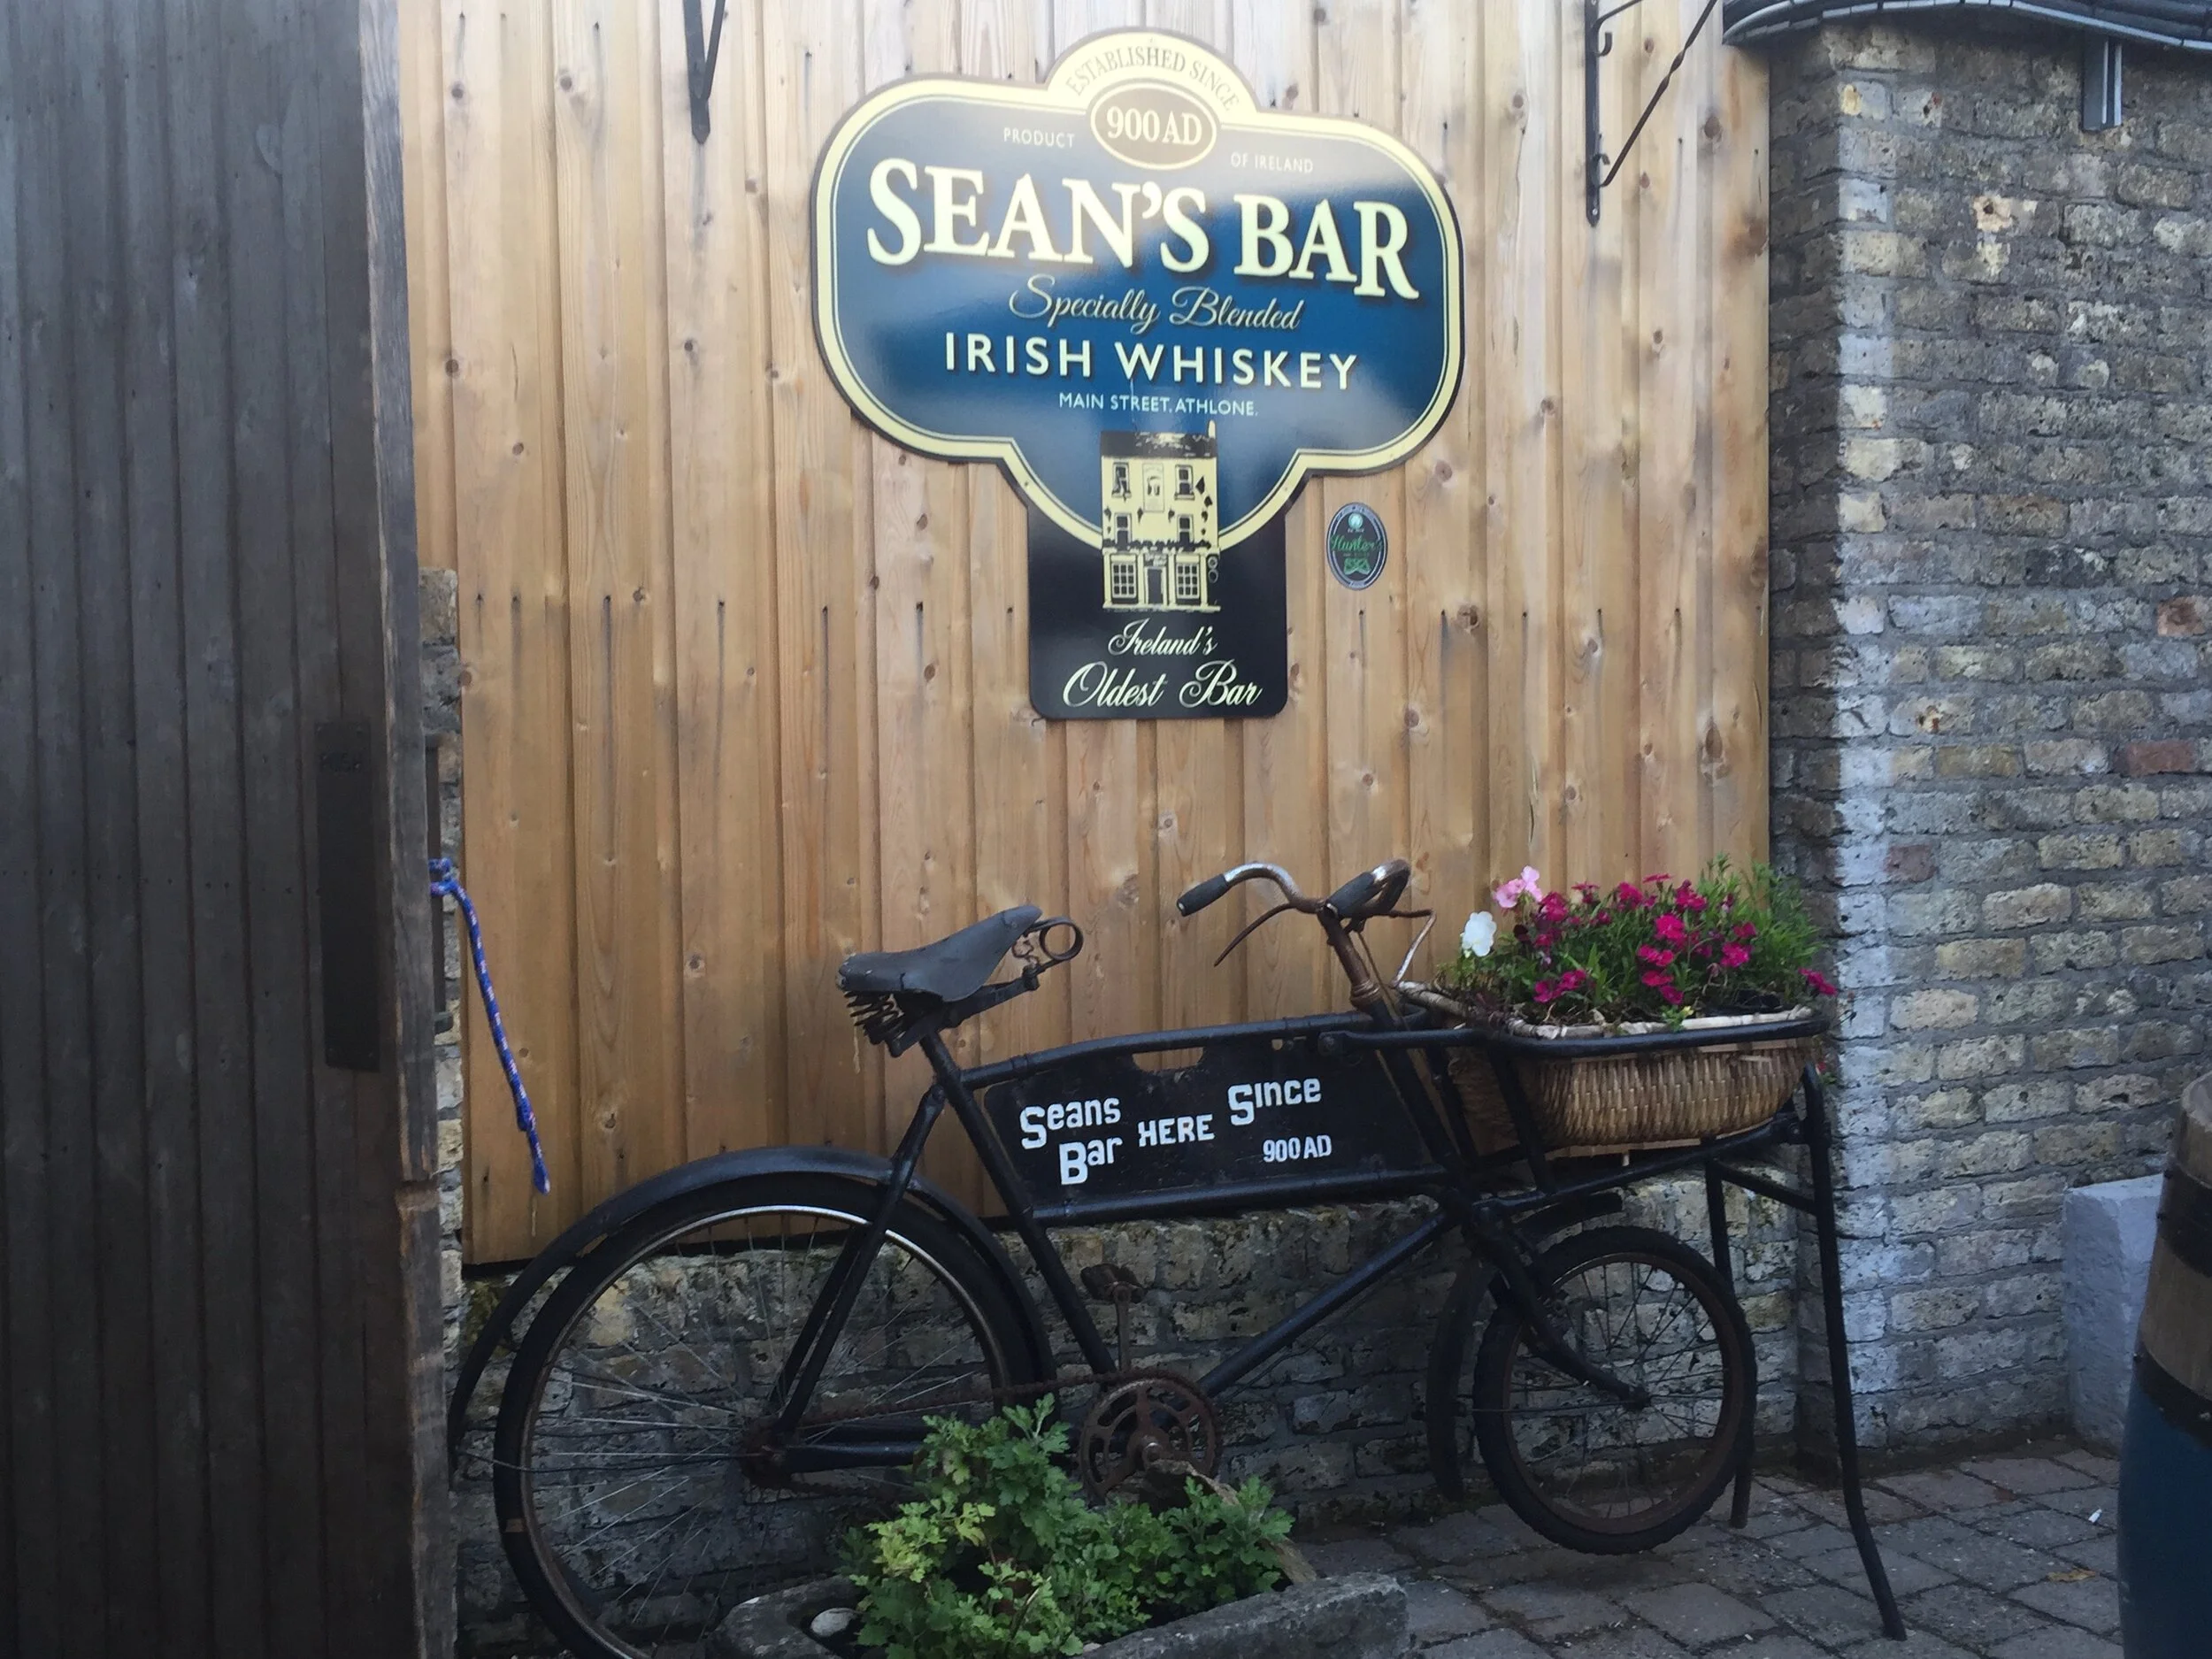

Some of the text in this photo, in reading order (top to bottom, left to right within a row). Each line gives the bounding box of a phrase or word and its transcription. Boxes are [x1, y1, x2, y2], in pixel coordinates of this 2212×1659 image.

[1065, 45, 1240, 111] ESTABLISHED SINCE
[1002, 127, 1076, 150] PRODUCT
[1230, 152, 1314, 173] OF IRELAND
[866, 157, 1419, 300] SEAN'S BAR
[1009, 274, 1305, 335] Specially Blended
[945, 332, 1357, 390] IRISH WHISKEY
[1058, 391, 1104, 410] MAIN
[1107, 618, 1218, 657] Ireland's
[1062, 658, 1263, 708] Oldest Bar
[1019, 1096, 1122, 1150] Seans
[1227, 1077, 1322, 1126] Since
[1058, 1113, 1216, 1186] Bar HERE
